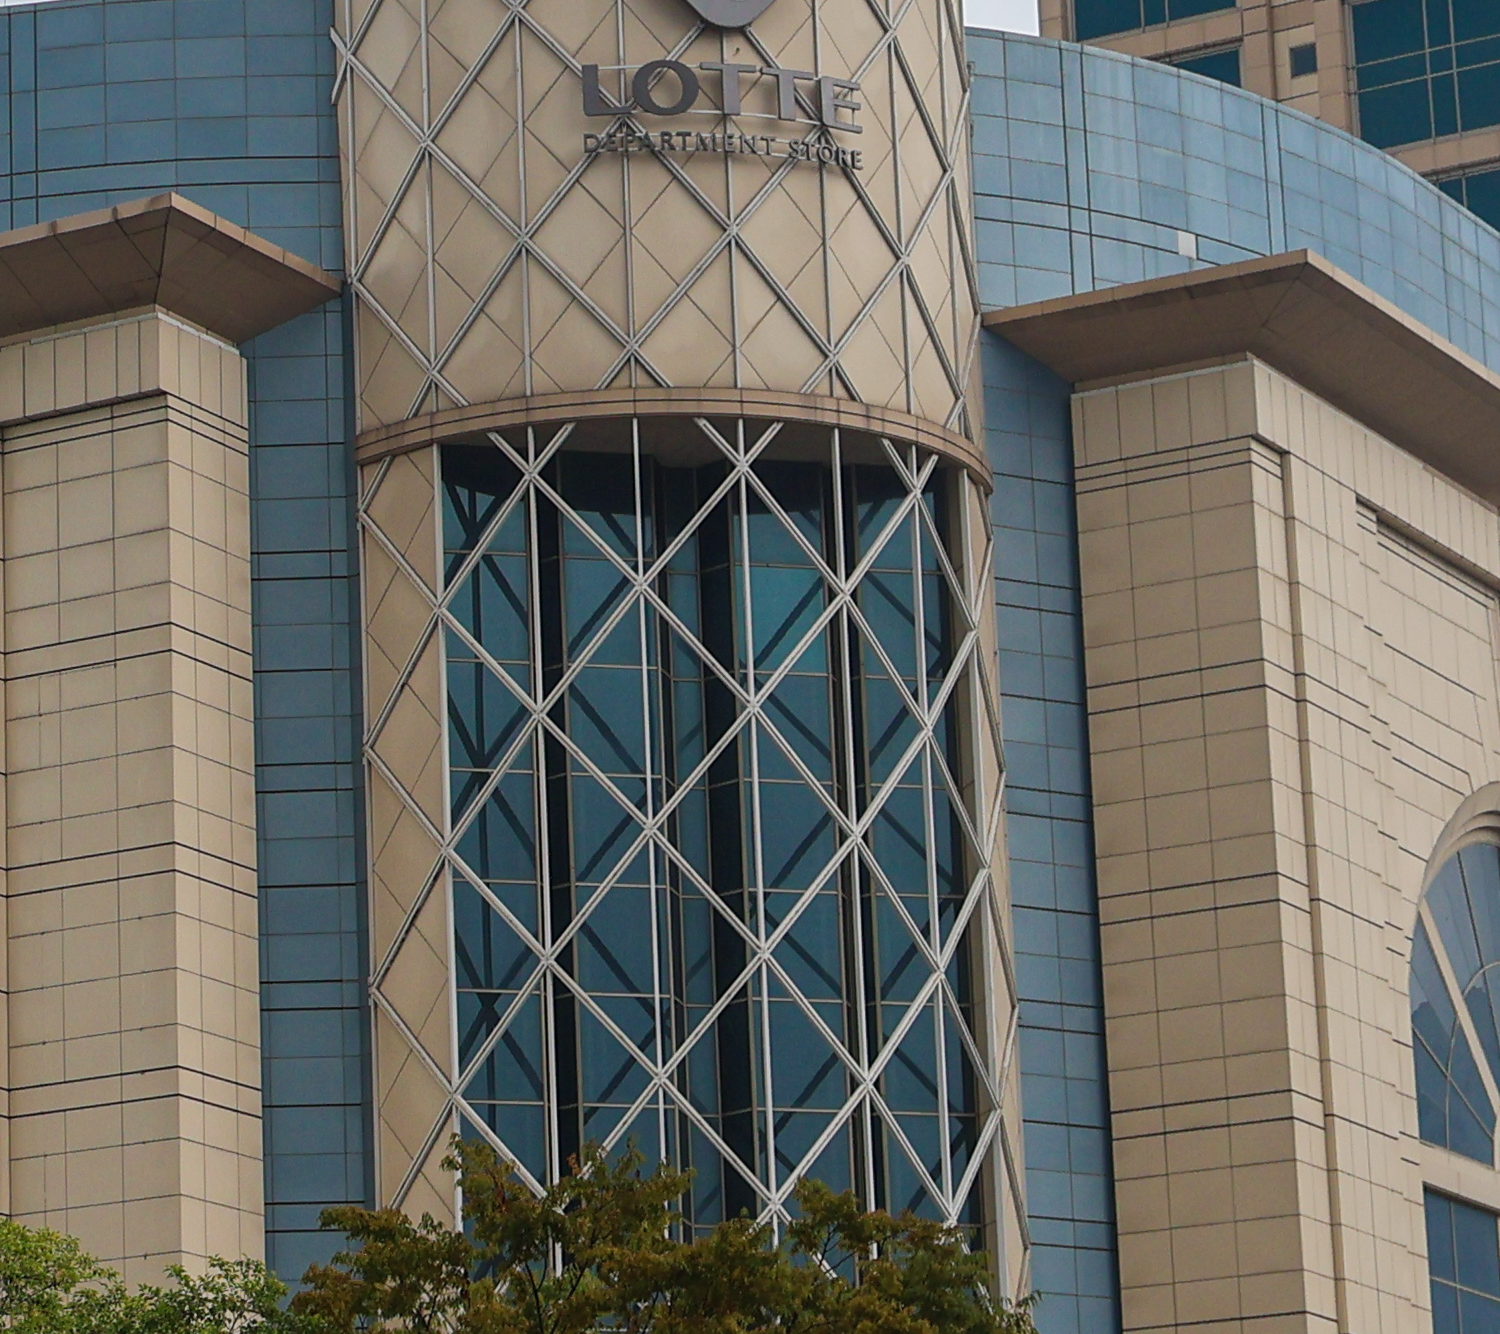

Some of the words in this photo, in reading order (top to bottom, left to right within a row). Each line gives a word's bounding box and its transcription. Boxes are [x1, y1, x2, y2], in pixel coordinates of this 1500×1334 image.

[582, 59, 863, 134] LOTTE
[583, 131, 777, 156] DEPARTMENT
[789, 139, 864, 171] STORE
